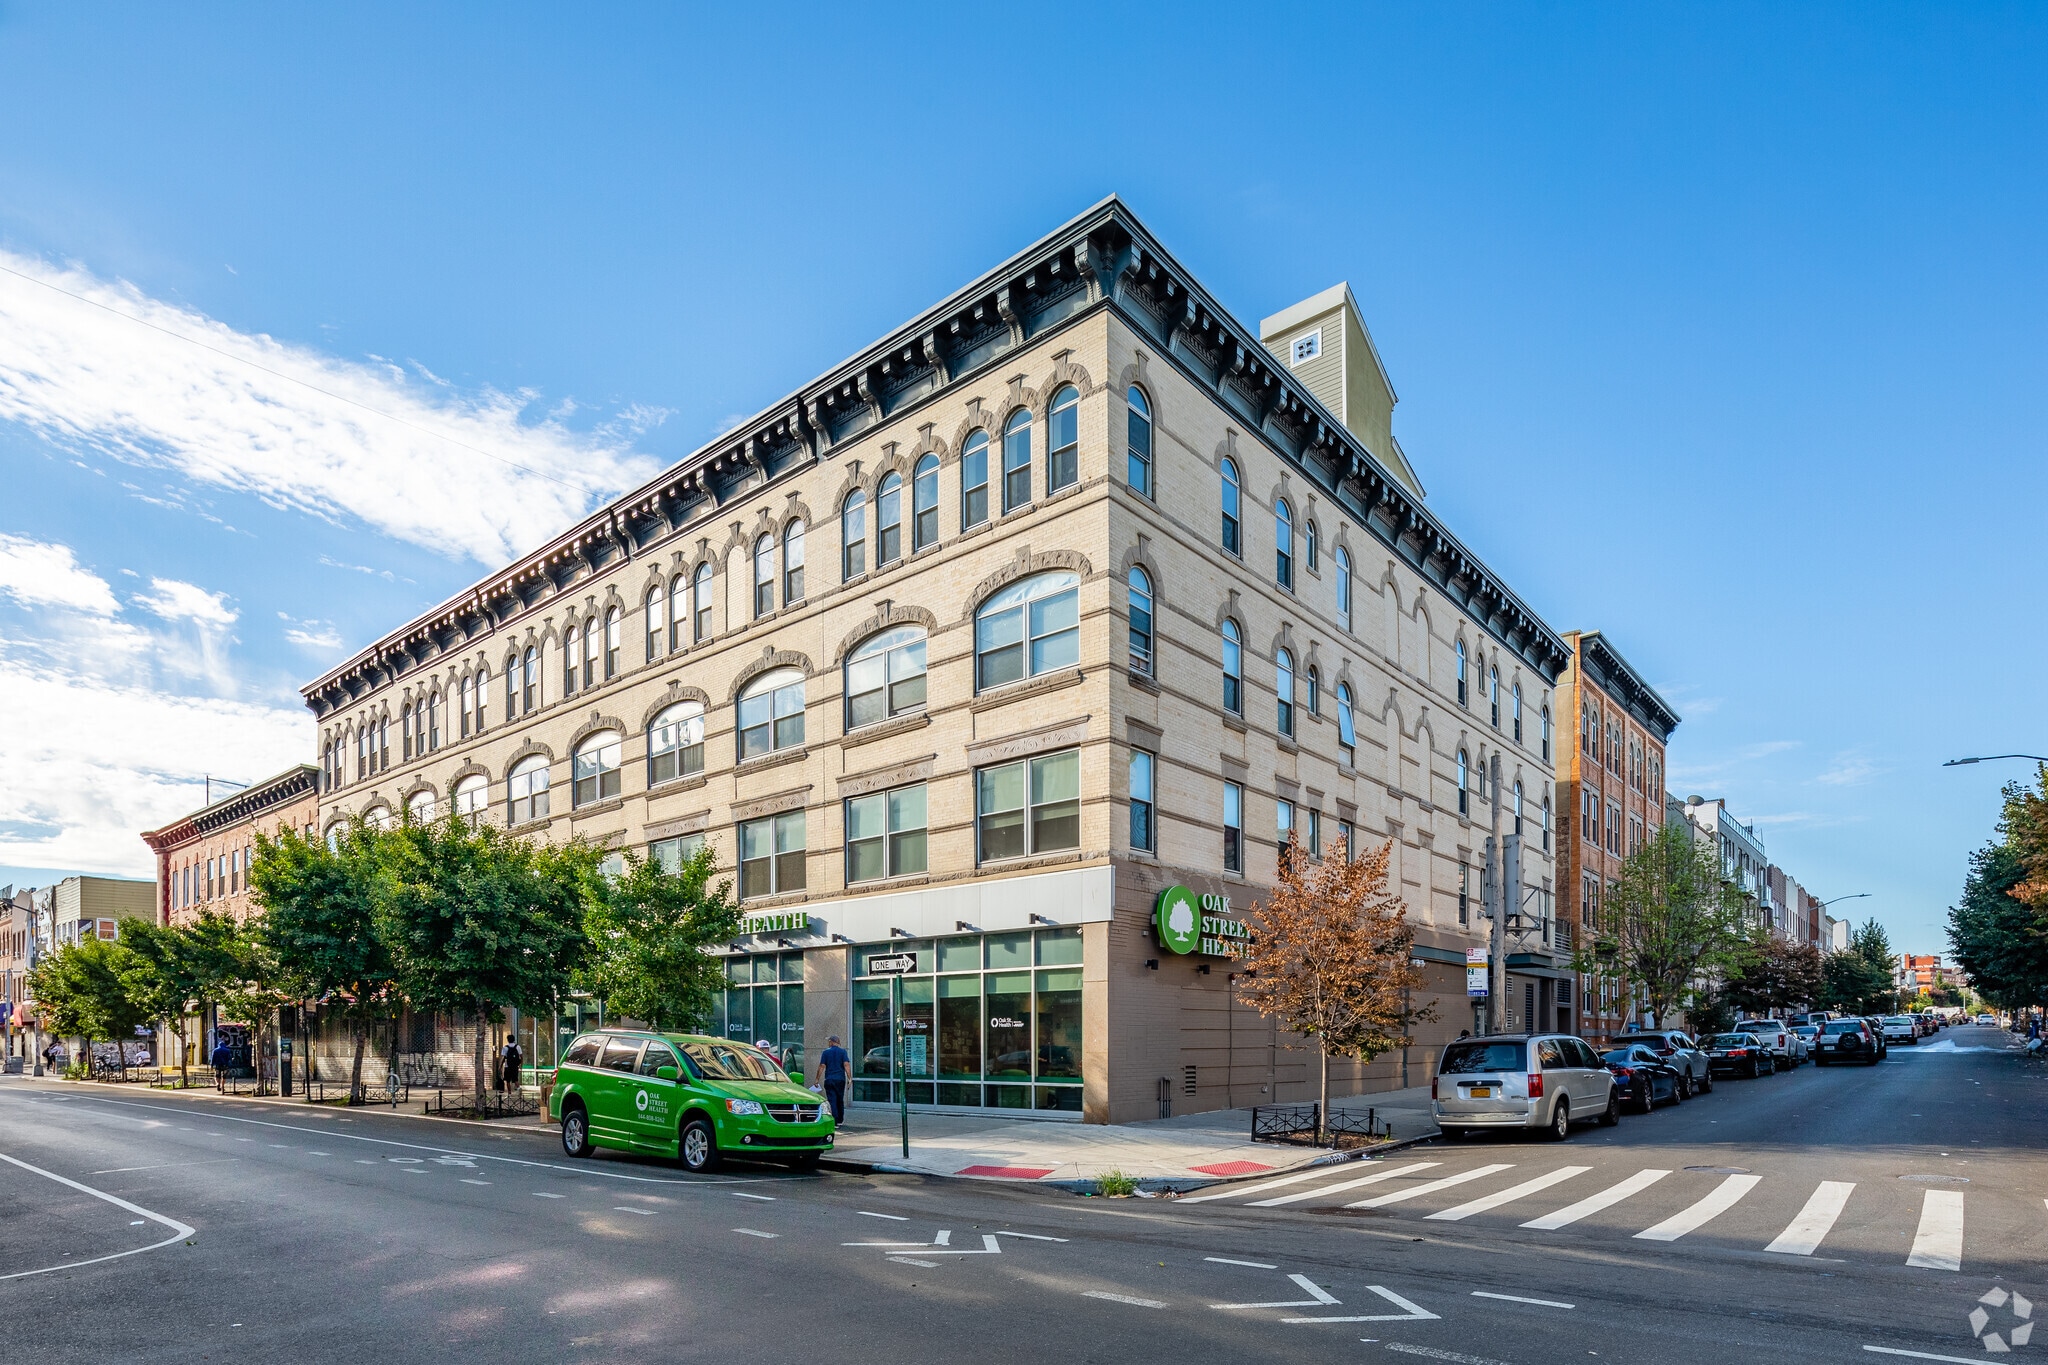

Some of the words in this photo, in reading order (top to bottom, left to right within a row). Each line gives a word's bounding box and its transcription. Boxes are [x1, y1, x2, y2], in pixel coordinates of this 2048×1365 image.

[1201, 893, 1231, 914] OAK
[740, 912, 806, 935] HEALTH
[875, 961, 889, 970] ONE
[896, 959, 909, 968] WAY
[649, 1099, 668, 1107] STREET
[648, 1105, 669, 1114] HEALTH
